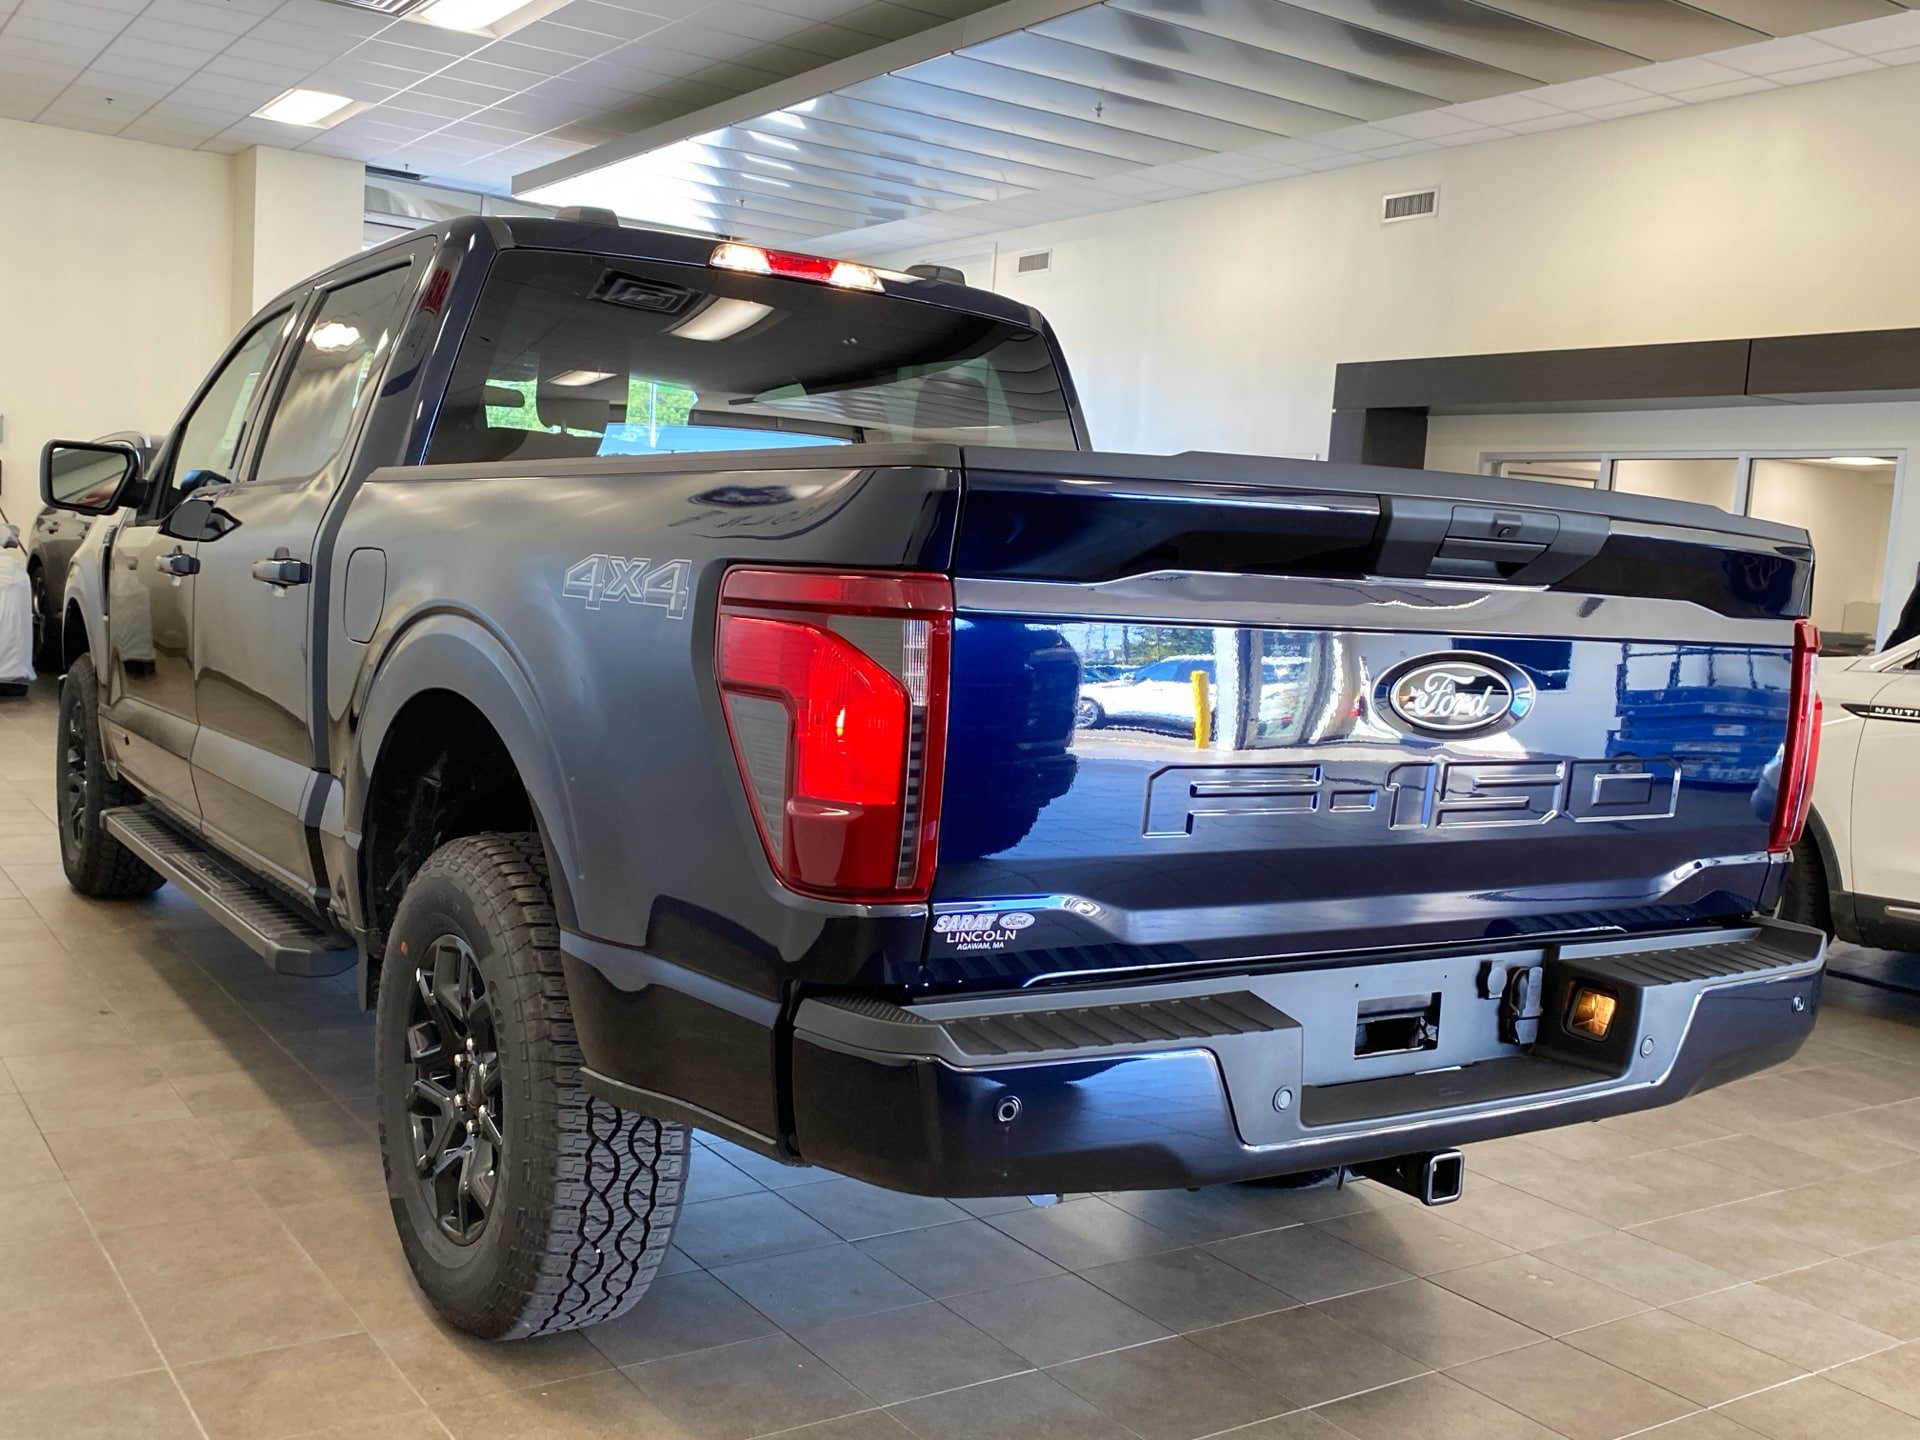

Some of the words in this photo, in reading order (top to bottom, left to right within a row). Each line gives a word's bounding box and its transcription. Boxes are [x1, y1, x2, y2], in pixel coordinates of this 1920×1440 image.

[563, 553, 692, 620] 4X4
[1413, 672, 1494, 717] Ford
[1875, 707, 1919, 717] NAUTI
[1142, 757, 1681, 838] F-150
[933, 913, 998, 932] SARAT
[946, 929, 1017, 943] LINCOLN
[956, 942, 991, 951] AGAWAM,
